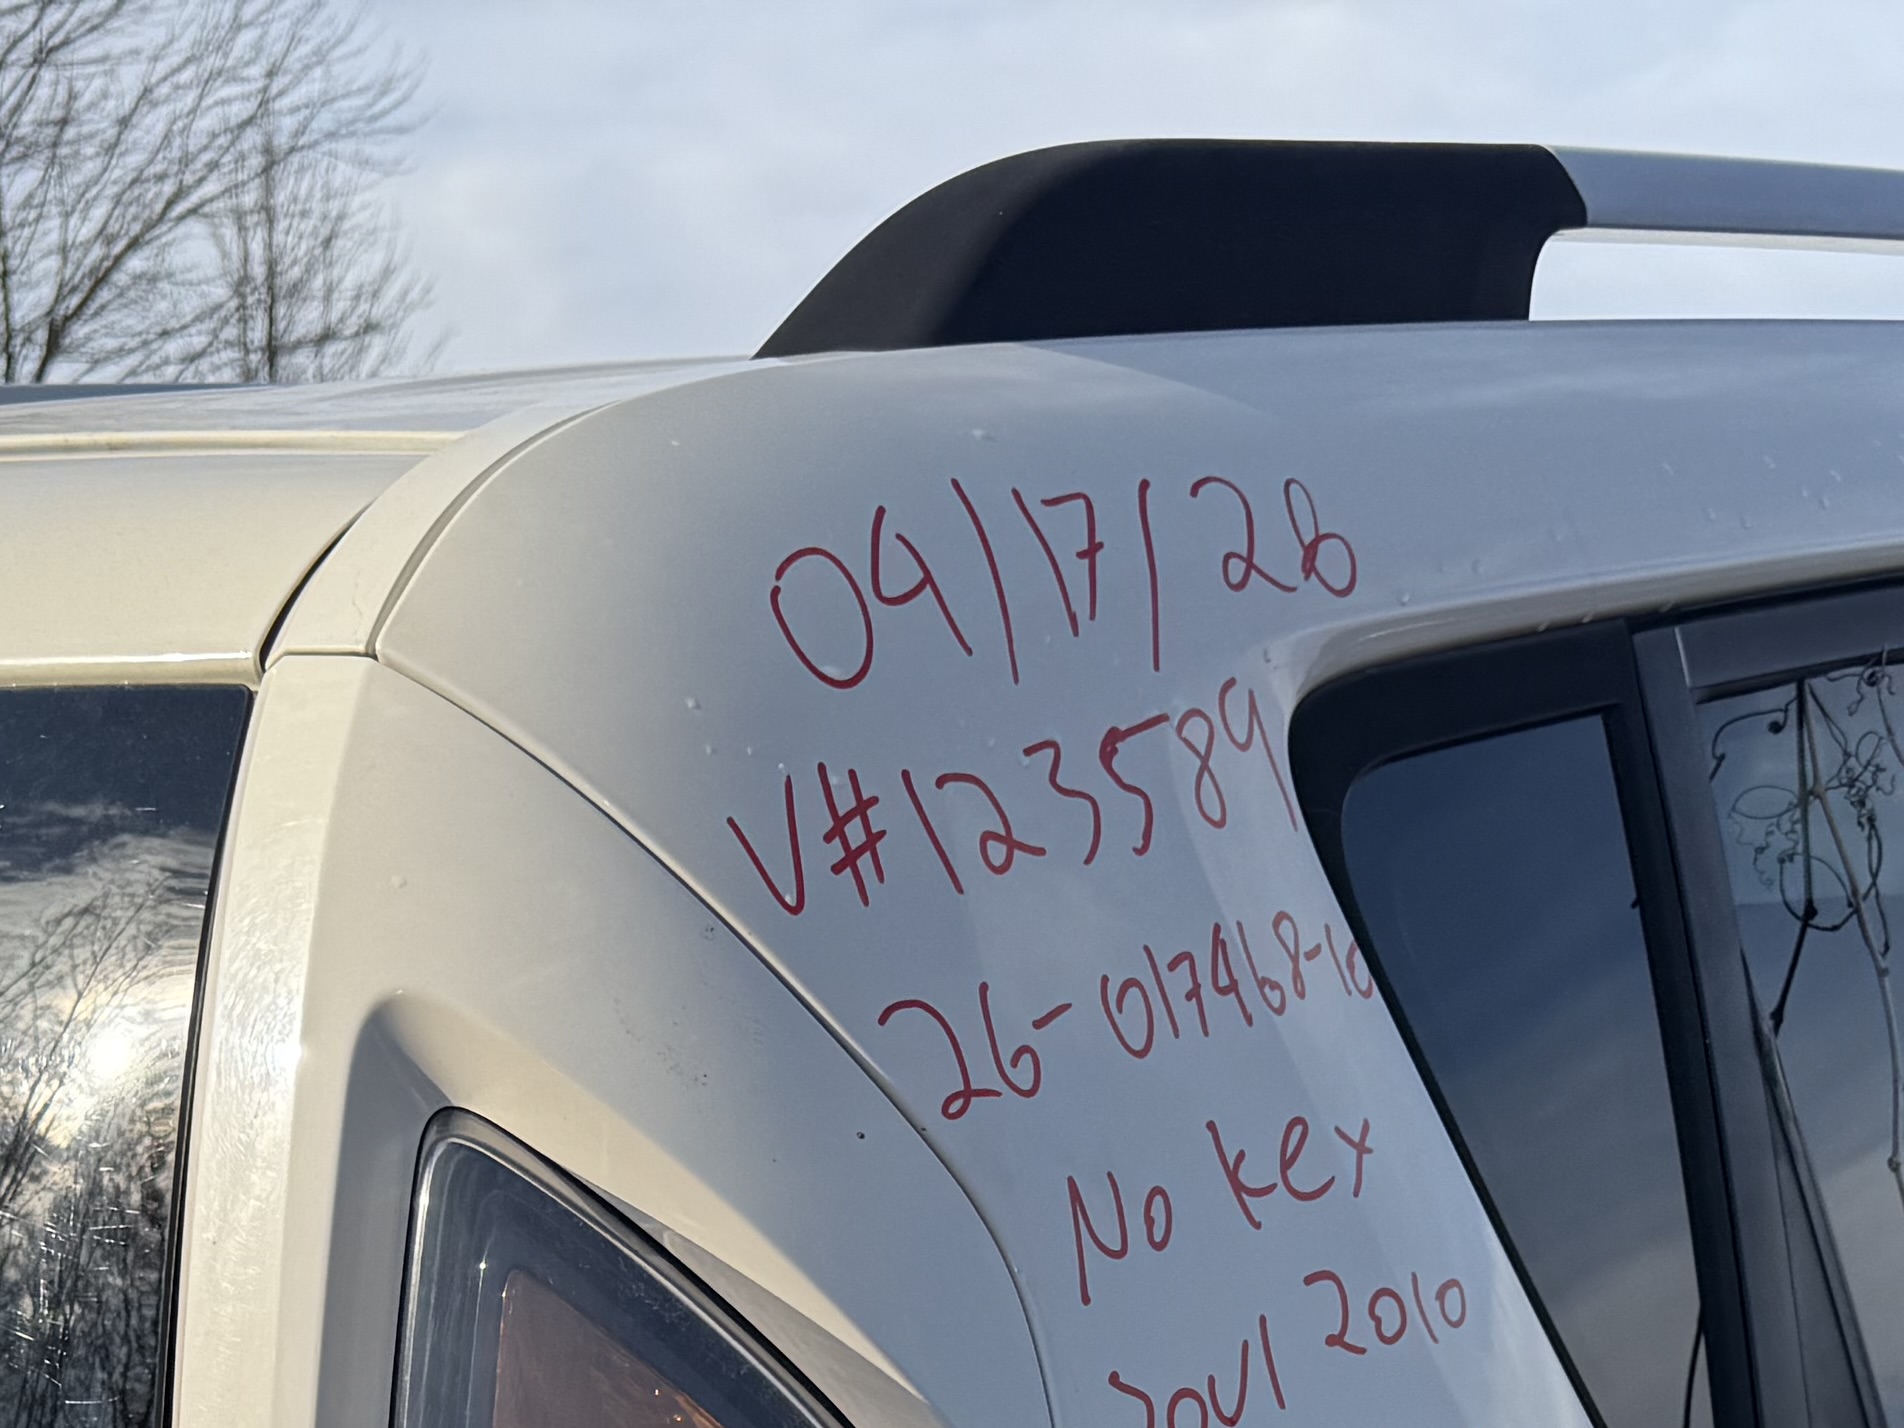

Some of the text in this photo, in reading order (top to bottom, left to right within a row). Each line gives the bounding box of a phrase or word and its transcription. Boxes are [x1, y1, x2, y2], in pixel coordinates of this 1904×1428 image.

[726, 675, 1299, 915] V#123589
[1066, 1170, 1174, 1306] No
[1302, 1268, 1467, 1356] 2010
